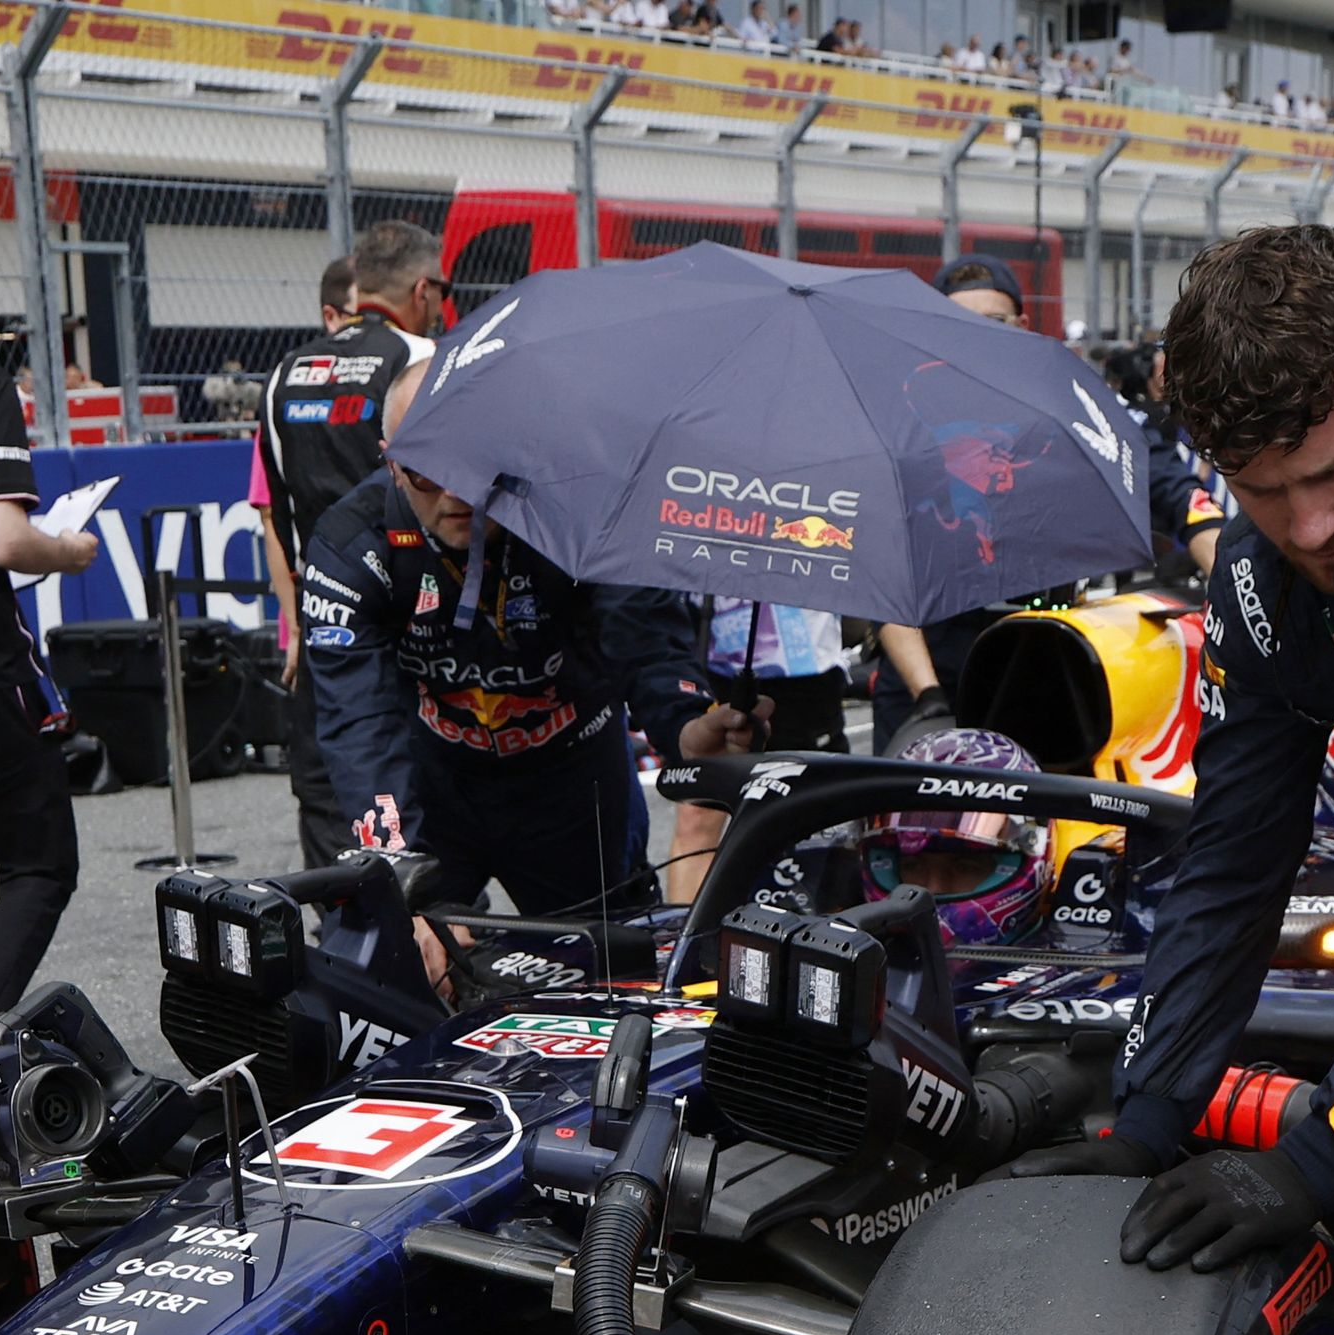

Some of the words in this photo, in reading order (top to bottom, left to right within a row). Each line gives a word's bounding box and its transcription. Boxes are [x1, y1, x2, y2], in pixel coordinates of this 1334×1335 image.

[277, 10, 423, 74] DHL
[533, 42, 651, 97] DHL
[741, 66, 835, 116] DHL
[915, 89, 997, 133] DHL
[1059, 108, 1127, 144] DHL
[666, 465, 861, 518] ORACLE
[660, 498, 713, 529] Red
[715, 507, 767, 538] Bull
[654, 537, 851, 582] RACING
[1203, 603, 1226, 647] bil
[1230, 556, 1282, 658] sparco
[398, 650, 564, 688] ORACLE
[417, 700, 494, 750] Red
[494, 702, 577, 758] Bull
[917, 776, 1030, 802] DAMAC
[1089, 791, 1125, 811] WELLS
[1124, 801, 1151, 818] FARGO
[1053, 904, 1112, 925] Gate
[532, 992, 717, 1011] ORACL
[901, 1057, 965, 1138] YETI
[66, 1164, 77, 1175] FR
[623, 1184, 643, 1200] FL
[169, 1223, 260, 1254] VISA
[186, 1246, 260, 1266] INFINITE
[142, 1258, 235, 1288] Gate
[123, 1288, 209, 1316] AT&T
